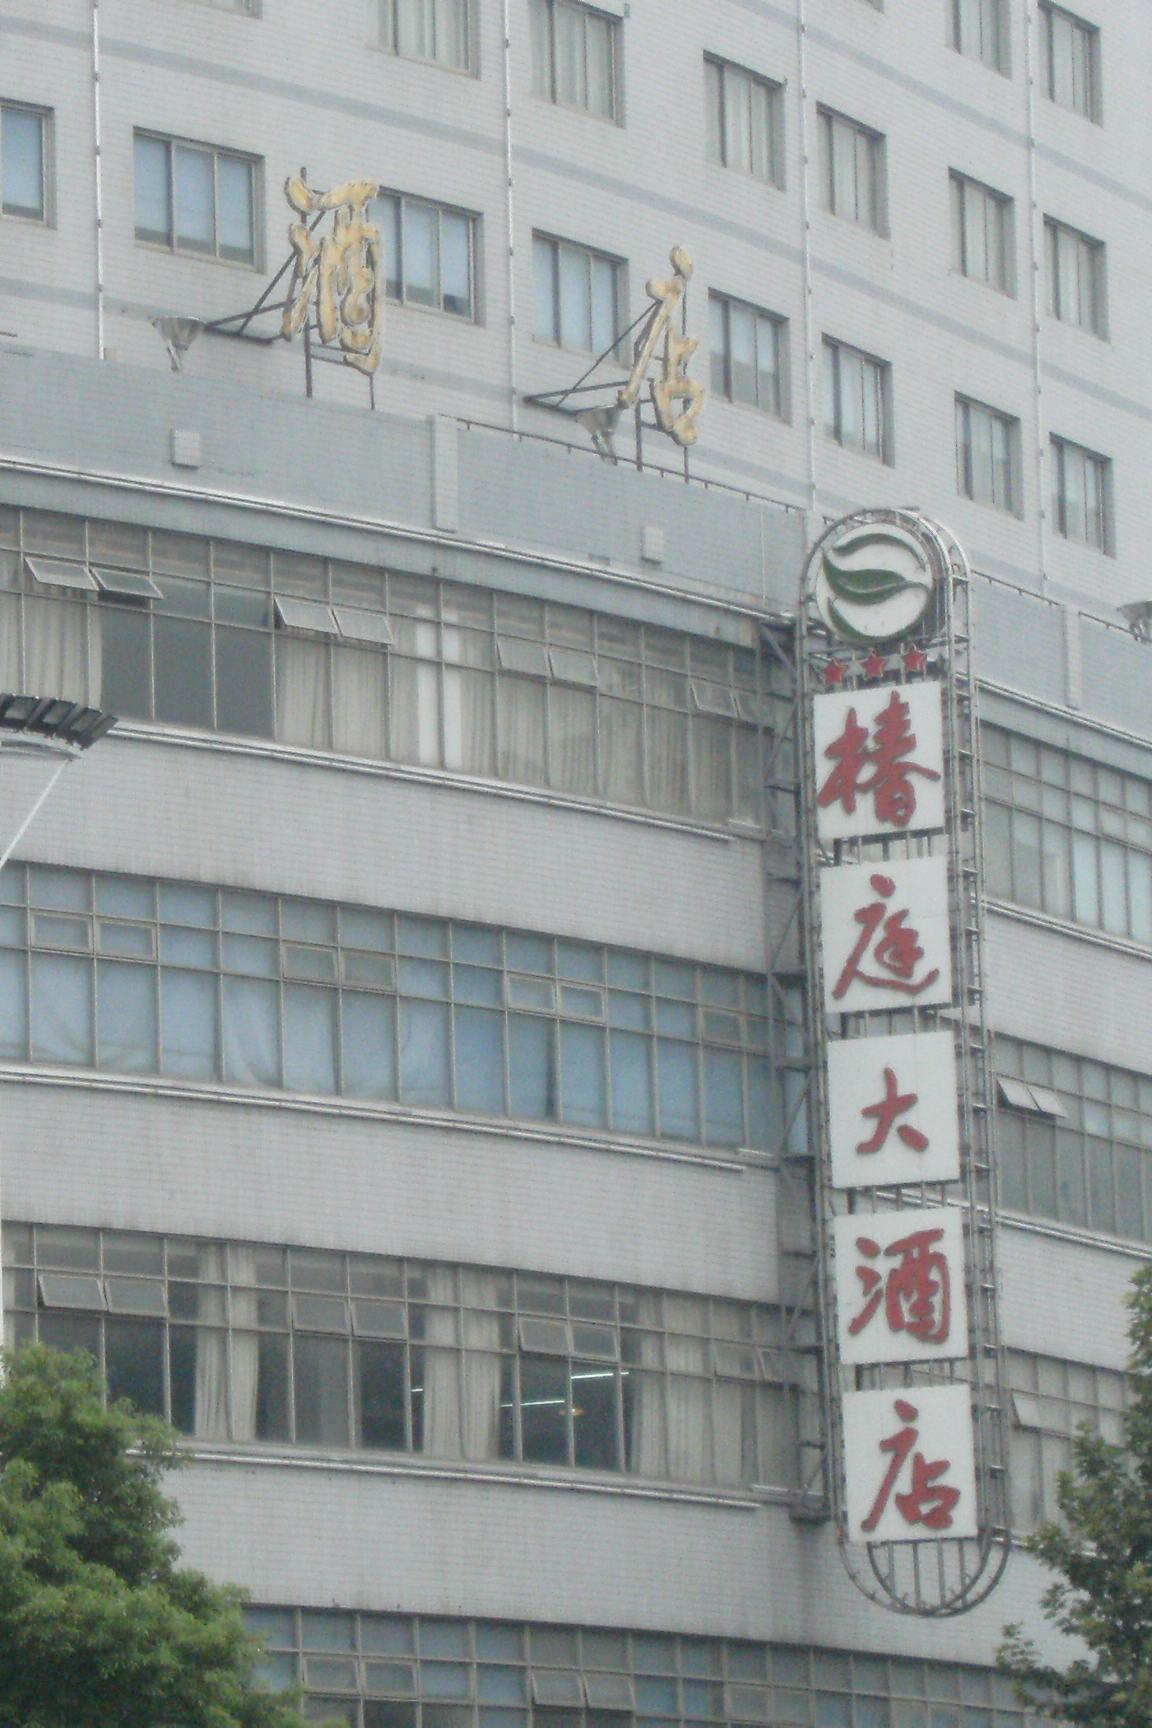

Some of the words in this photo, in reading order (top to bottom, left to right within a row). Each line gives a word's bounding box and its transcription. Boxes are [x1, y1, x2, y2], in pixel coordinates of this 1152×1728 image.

[816, 690, 961, 1532] 椿庭大酒店
